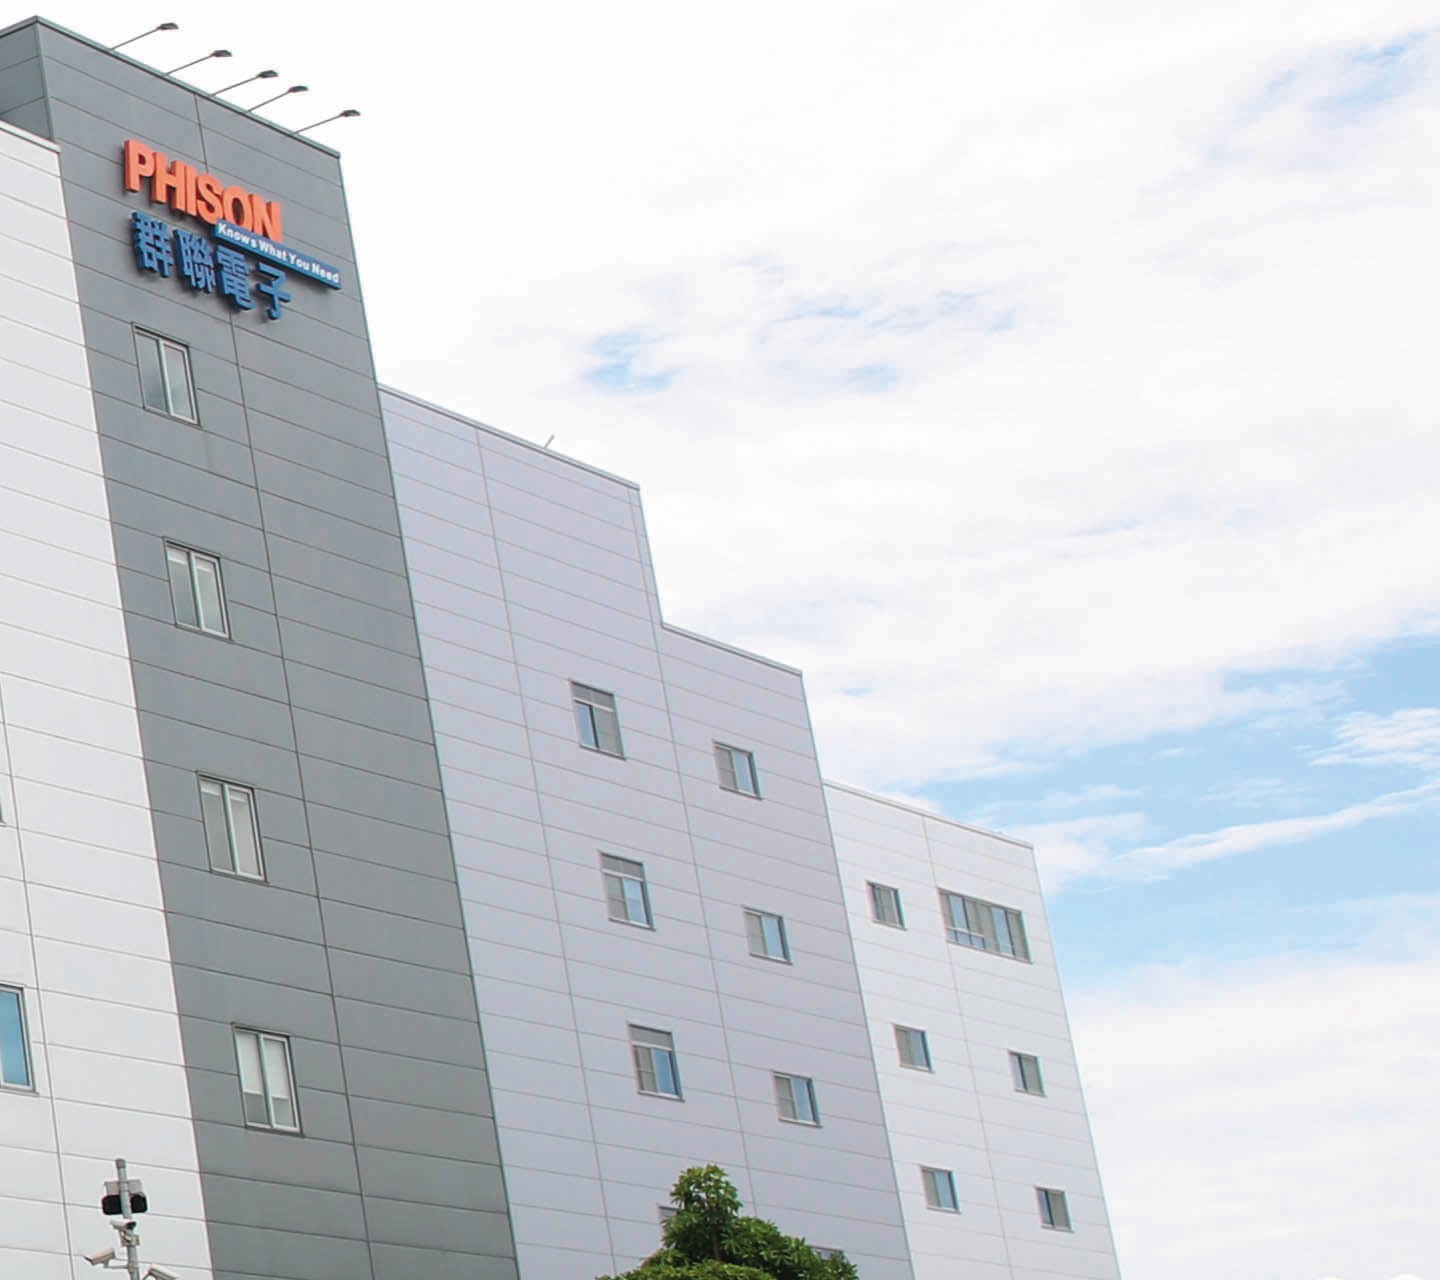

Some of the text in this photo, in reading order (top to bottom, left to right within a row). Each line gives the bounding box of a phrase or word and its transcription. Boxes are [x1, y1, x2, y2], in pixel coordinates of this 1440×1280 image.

[124, 139, 283, 243] PHISON
[132, 211, 292, 320] 群聯電子
[217, 222, 258, 249] Knows
[259, 239, 288, 261] What
[288, 251, 311, 271] You
